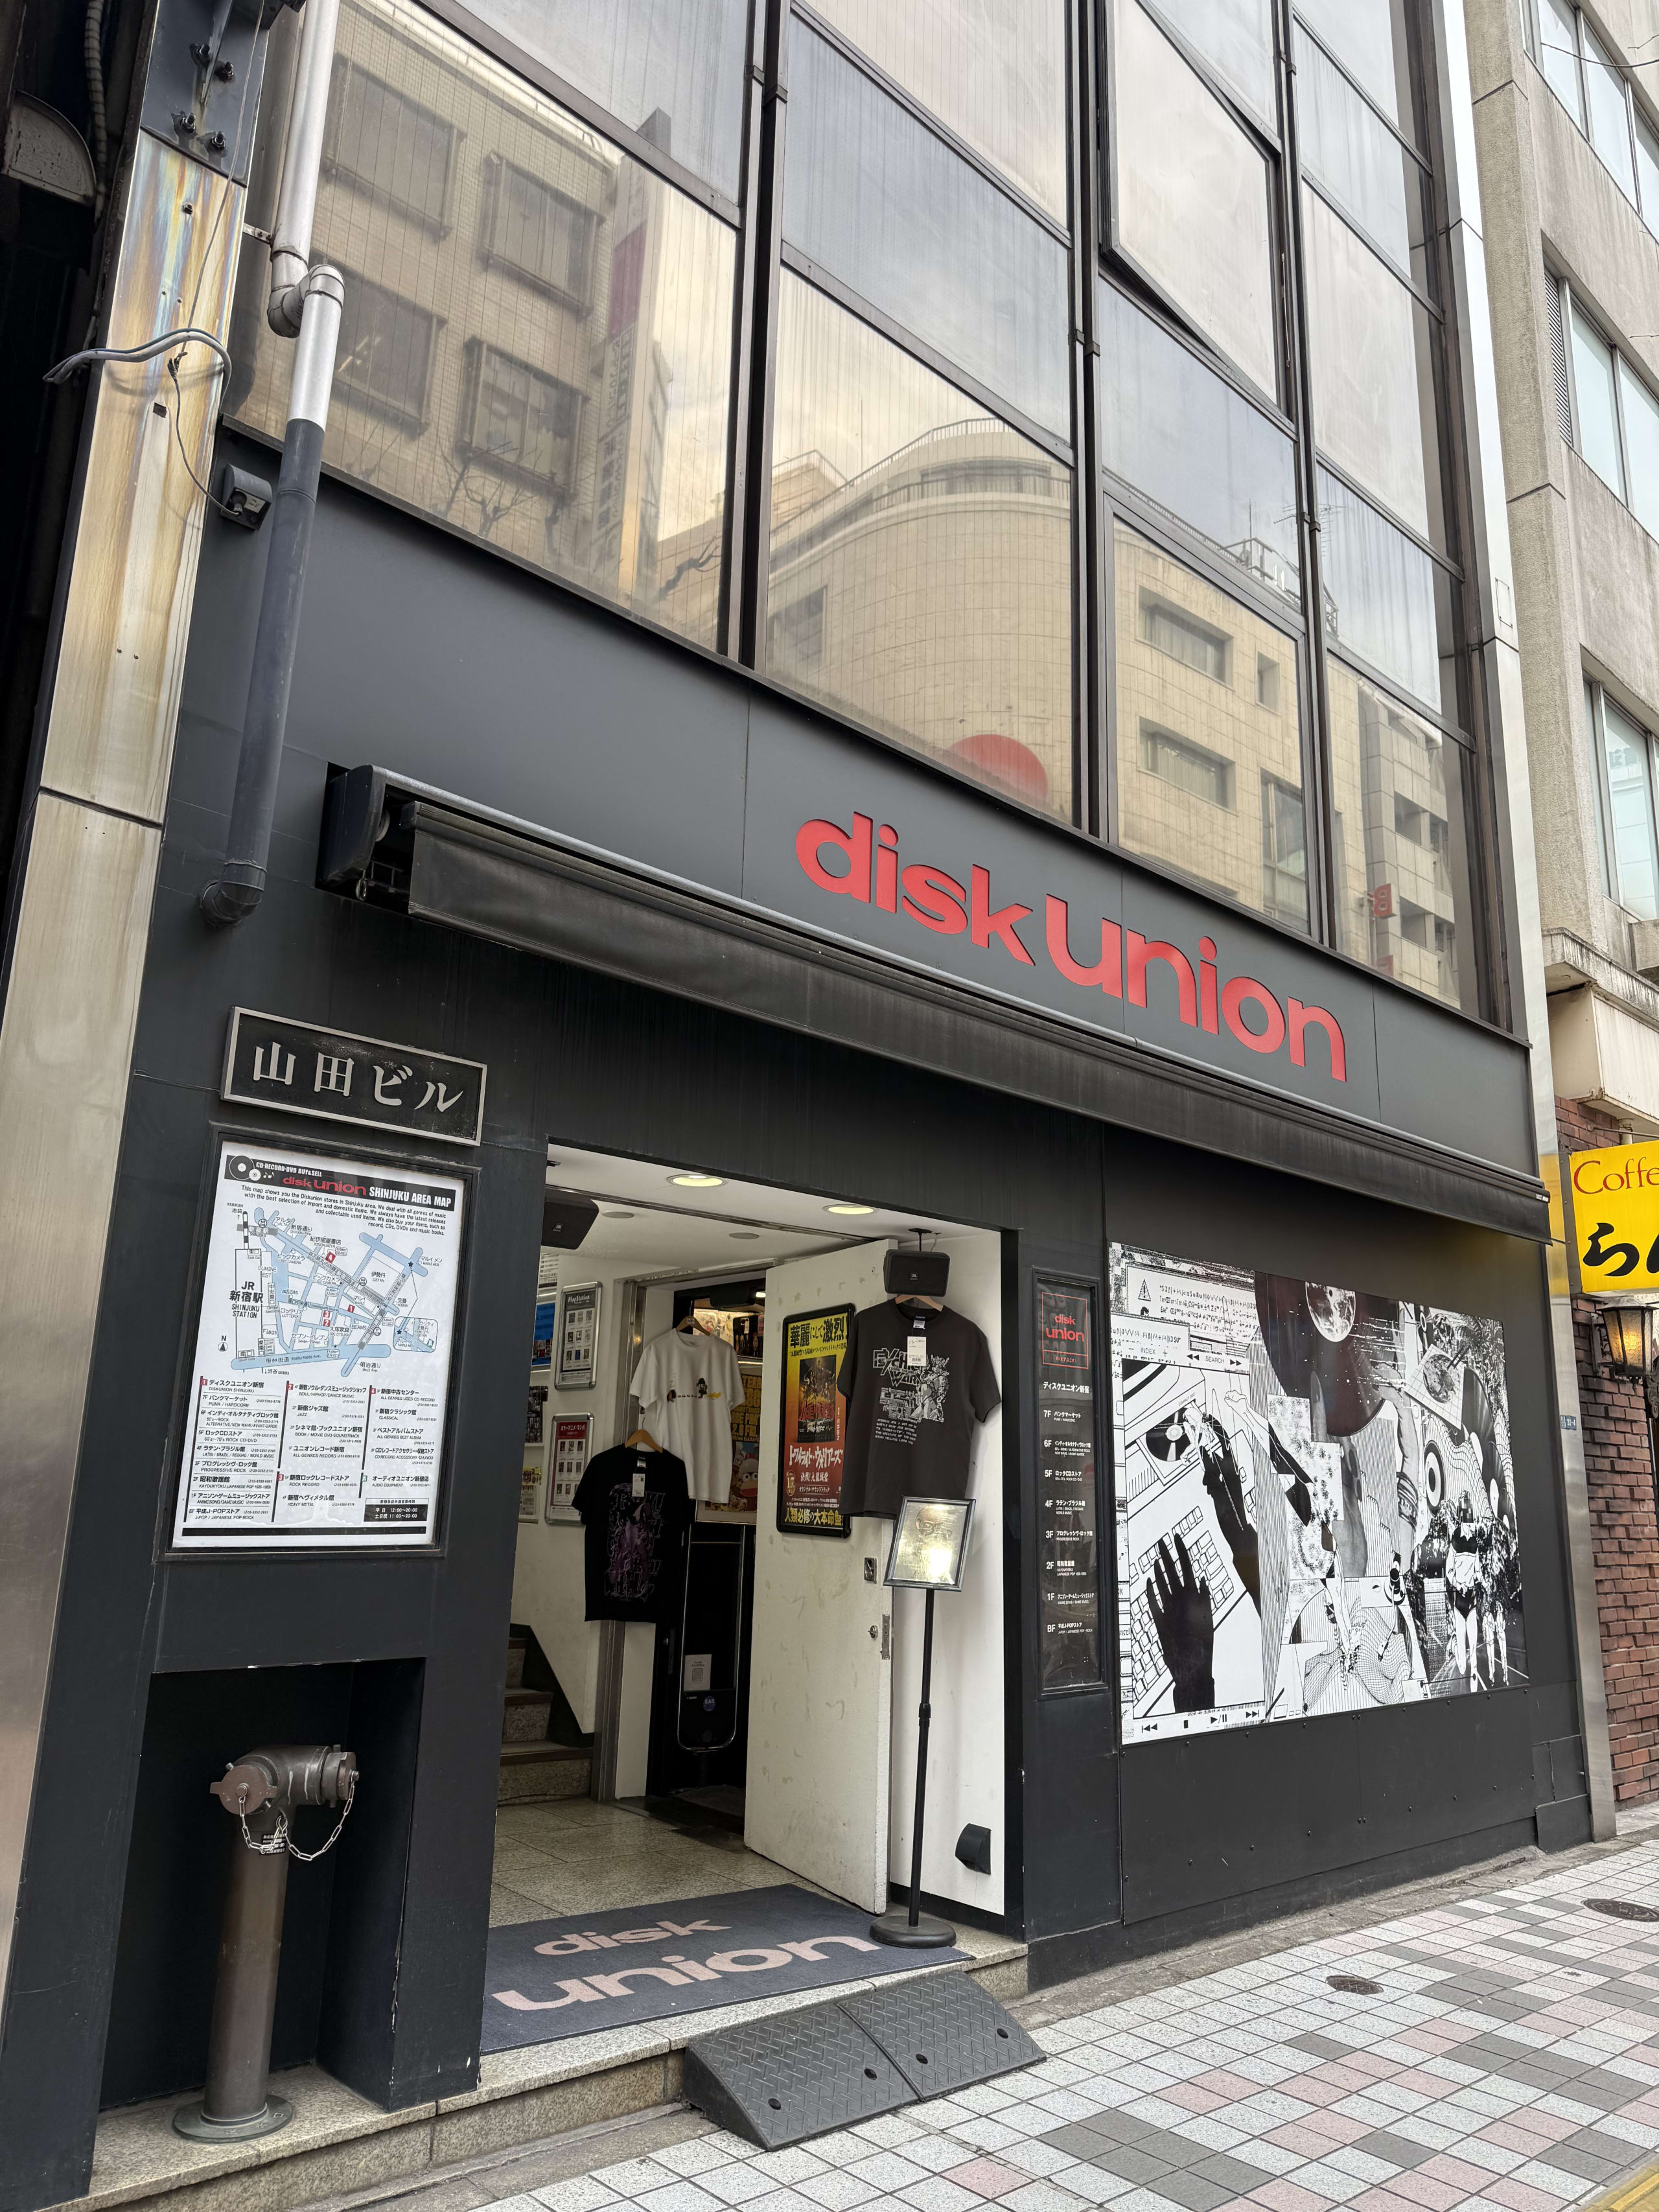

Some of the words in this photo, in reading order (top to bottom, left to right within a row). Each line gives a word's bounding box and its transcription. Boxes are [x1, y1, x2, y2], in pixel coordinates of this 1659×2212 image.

[253, 393, 464, 465] 山田ビル
[796, 810, 1036, 966] disk
[1046, 893, 1347, 1083] union
[298, 1168, 322, 1177] BUY&SELL
[1573, 1156, 1659, 1194] Coffe
[283, 1177, 312, 1188] disk
[314, 1180, 367, 1197] union
[369, 1187, 410, 1202] SHINJUKU
[411, 1193, 432, 1205] AREA
[434, 1196, 452, 1207] MAP
[301, 1193, 323, 1202] Diskunion
[325, 1209, 349, 1218] collectable
[242, 1281, 255, 1290] JR
[229, 1290, 263, 1303] 新宿駅
[231, 1303, 260, 1312] SHINJUKU
[1054, 1314, 1076, 1325] disk
[1045, 1327, 1084, 1342] union
[209, 1379, 264, 1388] ディスクユニオン新宿
[1043, 1381, 1089, 1393] ディスクユニオン新宿
[1043, 1410, 1051, 1418] 7F
[1045, 1469, 1052, 1478] 5F
[1045, 1530, 1054, 1539] 3F
[1047, 1624, 1056, 1633] BF
[534, 1919, 732, 1956] disk
[492, 1935, 882, 2010] union
